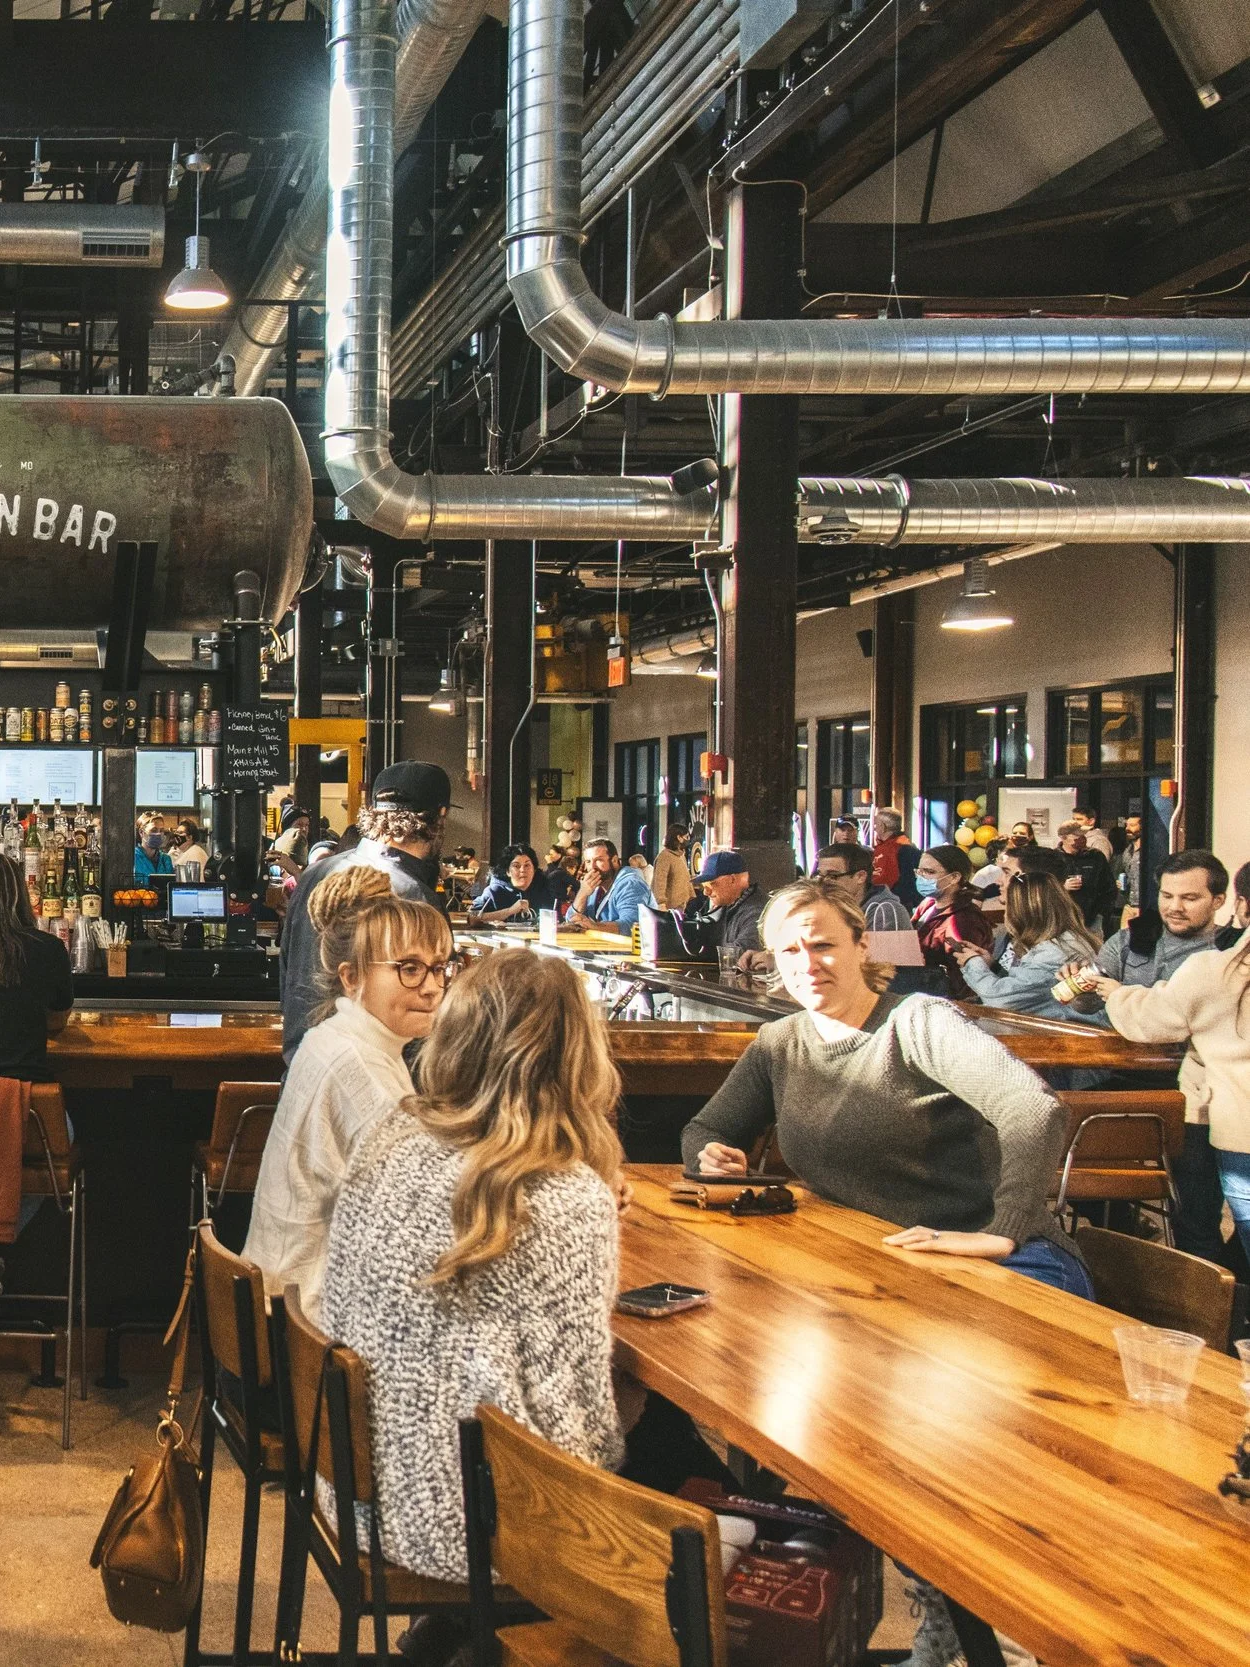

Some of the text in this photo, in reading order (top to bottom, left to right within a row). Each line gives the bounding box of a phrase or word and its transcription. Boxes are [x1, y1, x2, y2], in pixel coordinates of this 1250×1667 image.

[20, 461, 33, 470] MO
[32, 497, 117, 554] BAR
[227, 744, 246, 755] Main
[253, 745, 268, 756] Mill
[233, 769, 259, 781] Morning
